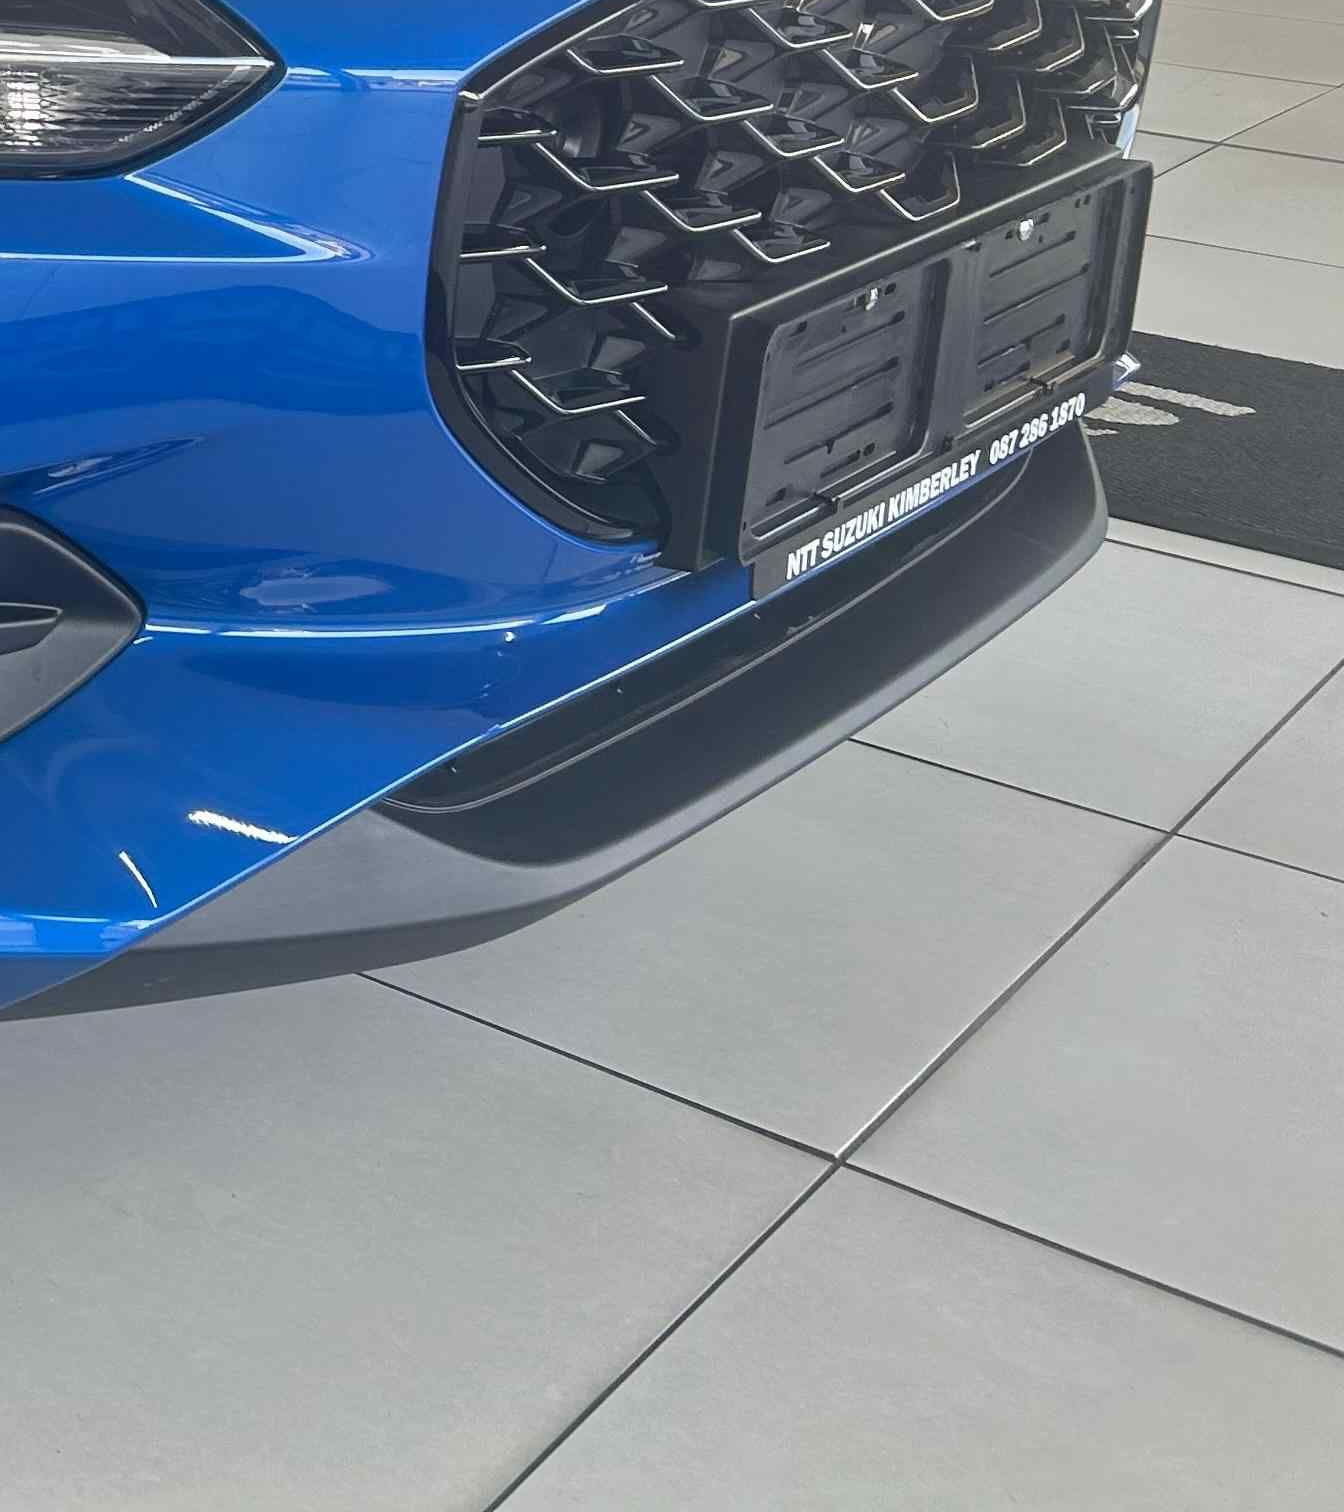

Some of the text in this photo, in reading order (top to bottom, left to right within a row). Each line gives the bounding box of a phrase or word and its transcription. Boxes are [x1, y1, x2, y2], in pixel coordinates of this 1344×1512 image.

[786, 541, 820, 580] NTT
[821, 502, 885, 559] SUZUKI
[888, 449, 981, 522] KIMBERLEY
[989, 429, 1019, 465] 087
[1049, 392, 1086, 431] 1870
